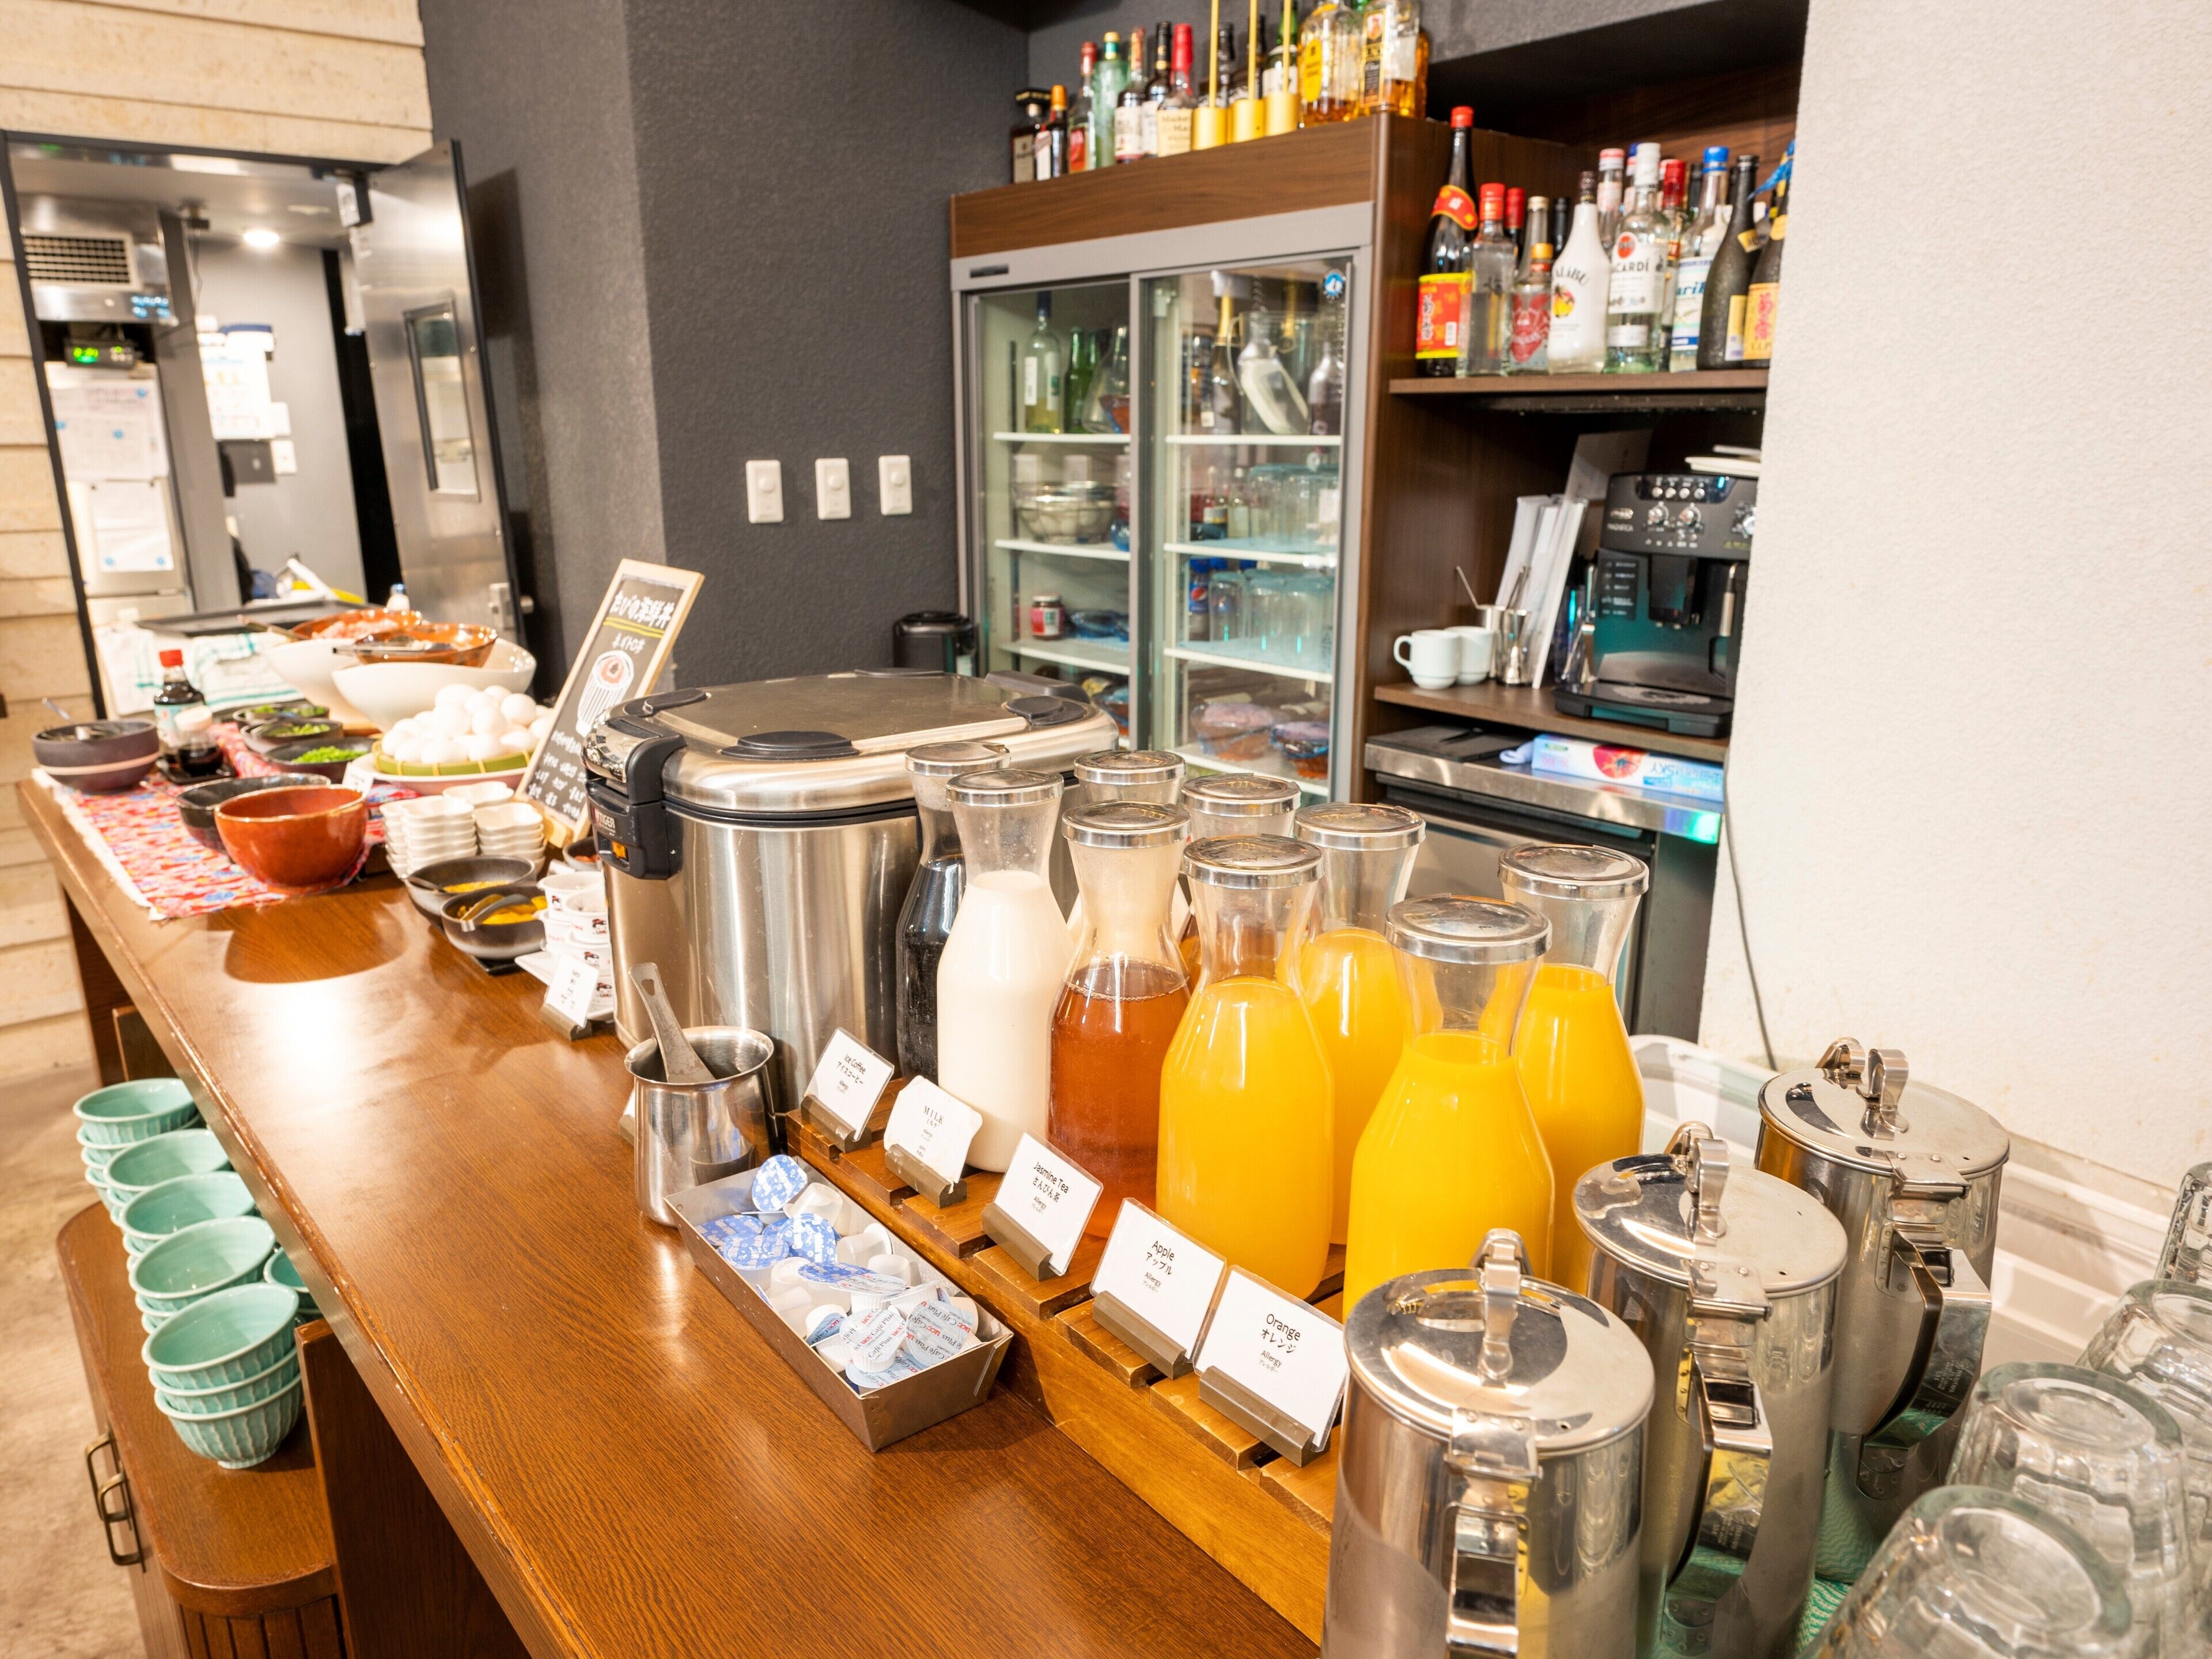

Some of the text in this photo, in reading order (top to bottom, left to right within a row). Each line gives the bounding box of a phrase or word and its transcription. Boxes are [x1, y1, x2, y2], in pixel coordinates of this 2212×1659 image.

[599, 812, 616, 830] TIGER
[837, 1061, 863, 1084] アイスコーヒー
[851, 1059, 866, 1074] Coffee
[923, 1105, 944, 1124] MILK
[1033, 1161, 1069, 1194] Jasmine Tea
[1152, 1240, 1175, 1262] Apple
[1145, 1251, 1172, 1275] アップル
[1144, 1272, 1162, 1288] Allergy
[927, 1304, 942, 1317] Plus
[941, 1313, 957, 1326] Café
[871, 1323, 884, 1336] Café
[882, 1313, 895, 1325] Plus
[912, 1316, 926, 1328] Café
[1266, 1313, 1301, 1341] Orange
[868, 1346, 881, 1358] Café
[880, 1336, 893, 1347] Plus
[915, 1338, 930, 1351] Plus
[942, 1334, 957, 1347] Plus
[1260, 1328, 1297, 1354] オレンジ
[929, 1347, 945, 1360] Café
[1260, 1350, 1282, 1368] Allergy
